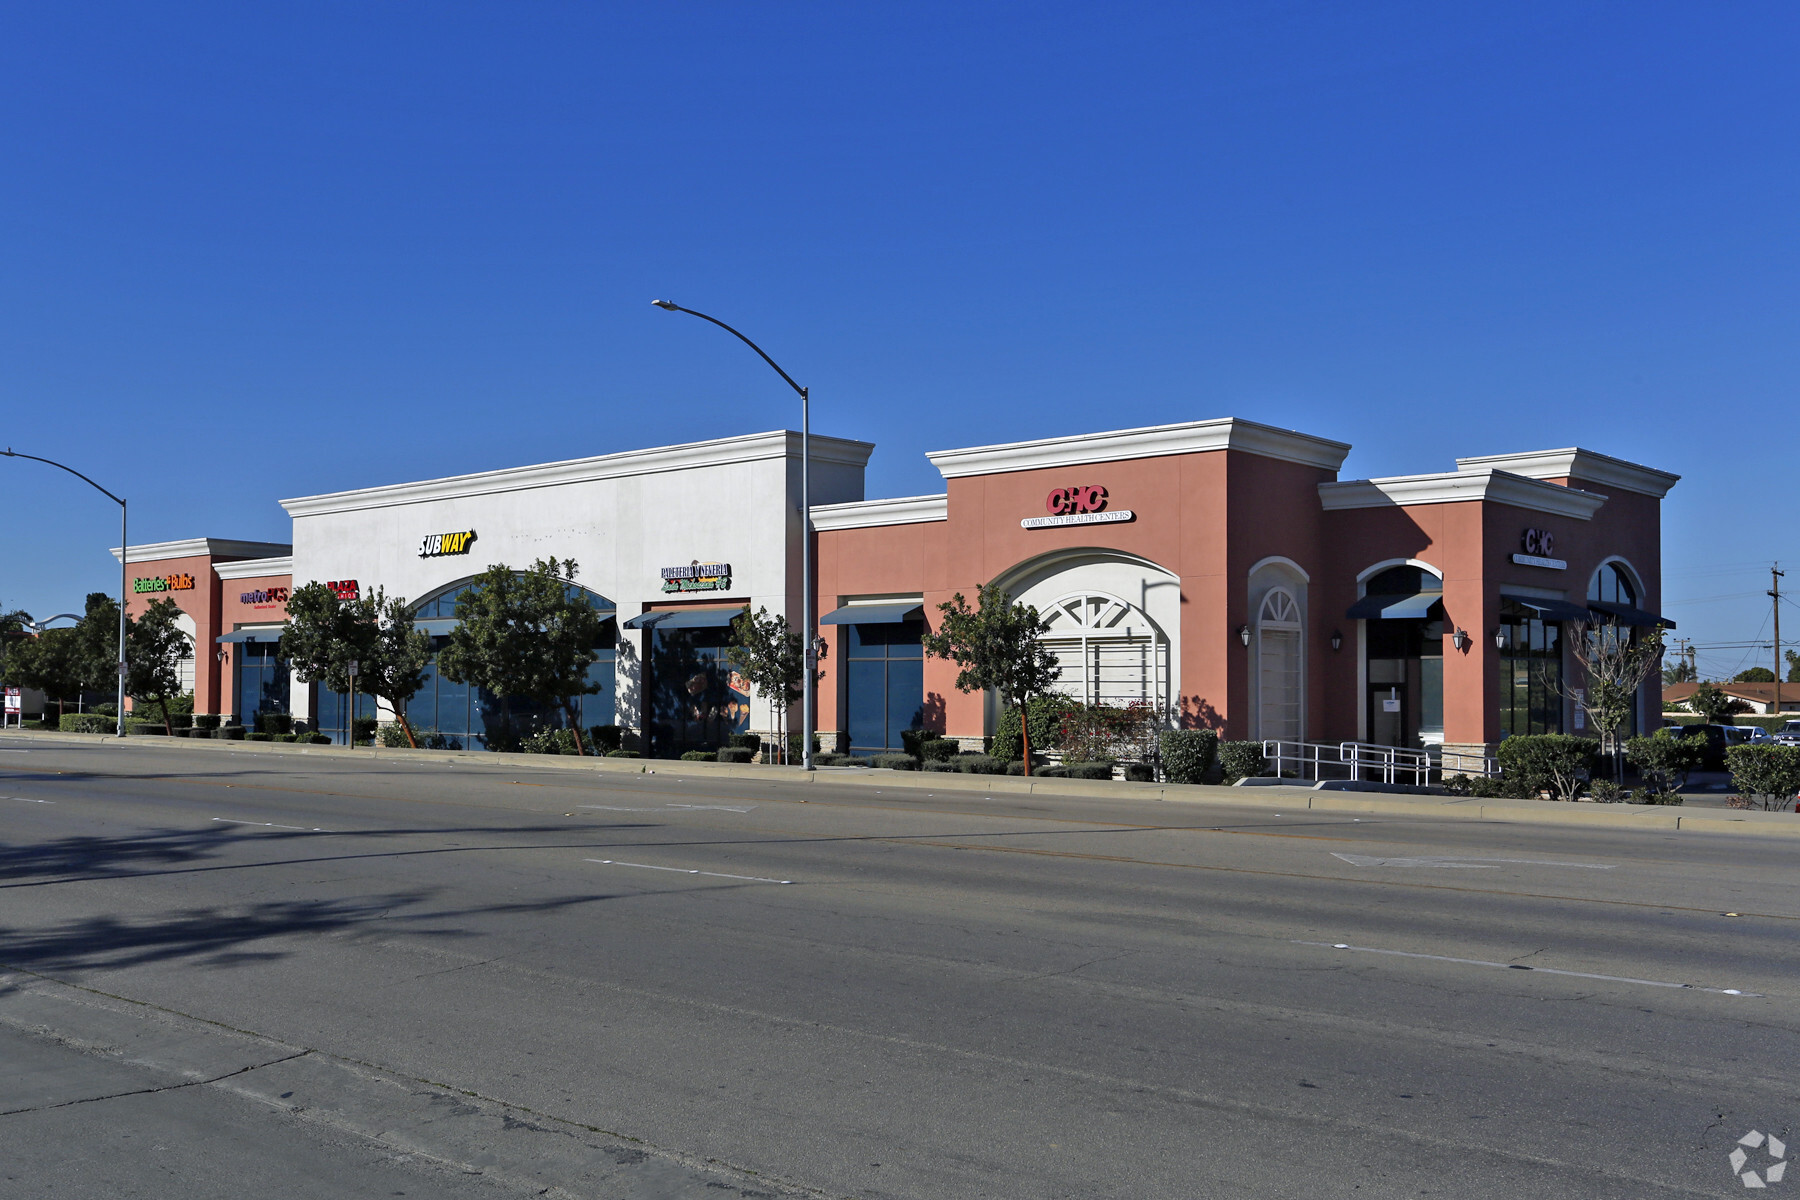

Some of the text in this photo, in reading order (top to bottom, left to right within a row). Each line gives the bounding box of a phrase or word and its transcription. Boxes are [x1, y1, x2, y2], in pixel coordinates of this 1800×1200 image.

[1046, 485, 1104, 514] CHC
[1023, 511, 1130, 526] COMMUNITY HEALTH CENTERS
[417, 532, 472, 555] SUBWAY
[1526, 528, 1553, 556] CHC
[327, 580, 356, 591] PLAZA
